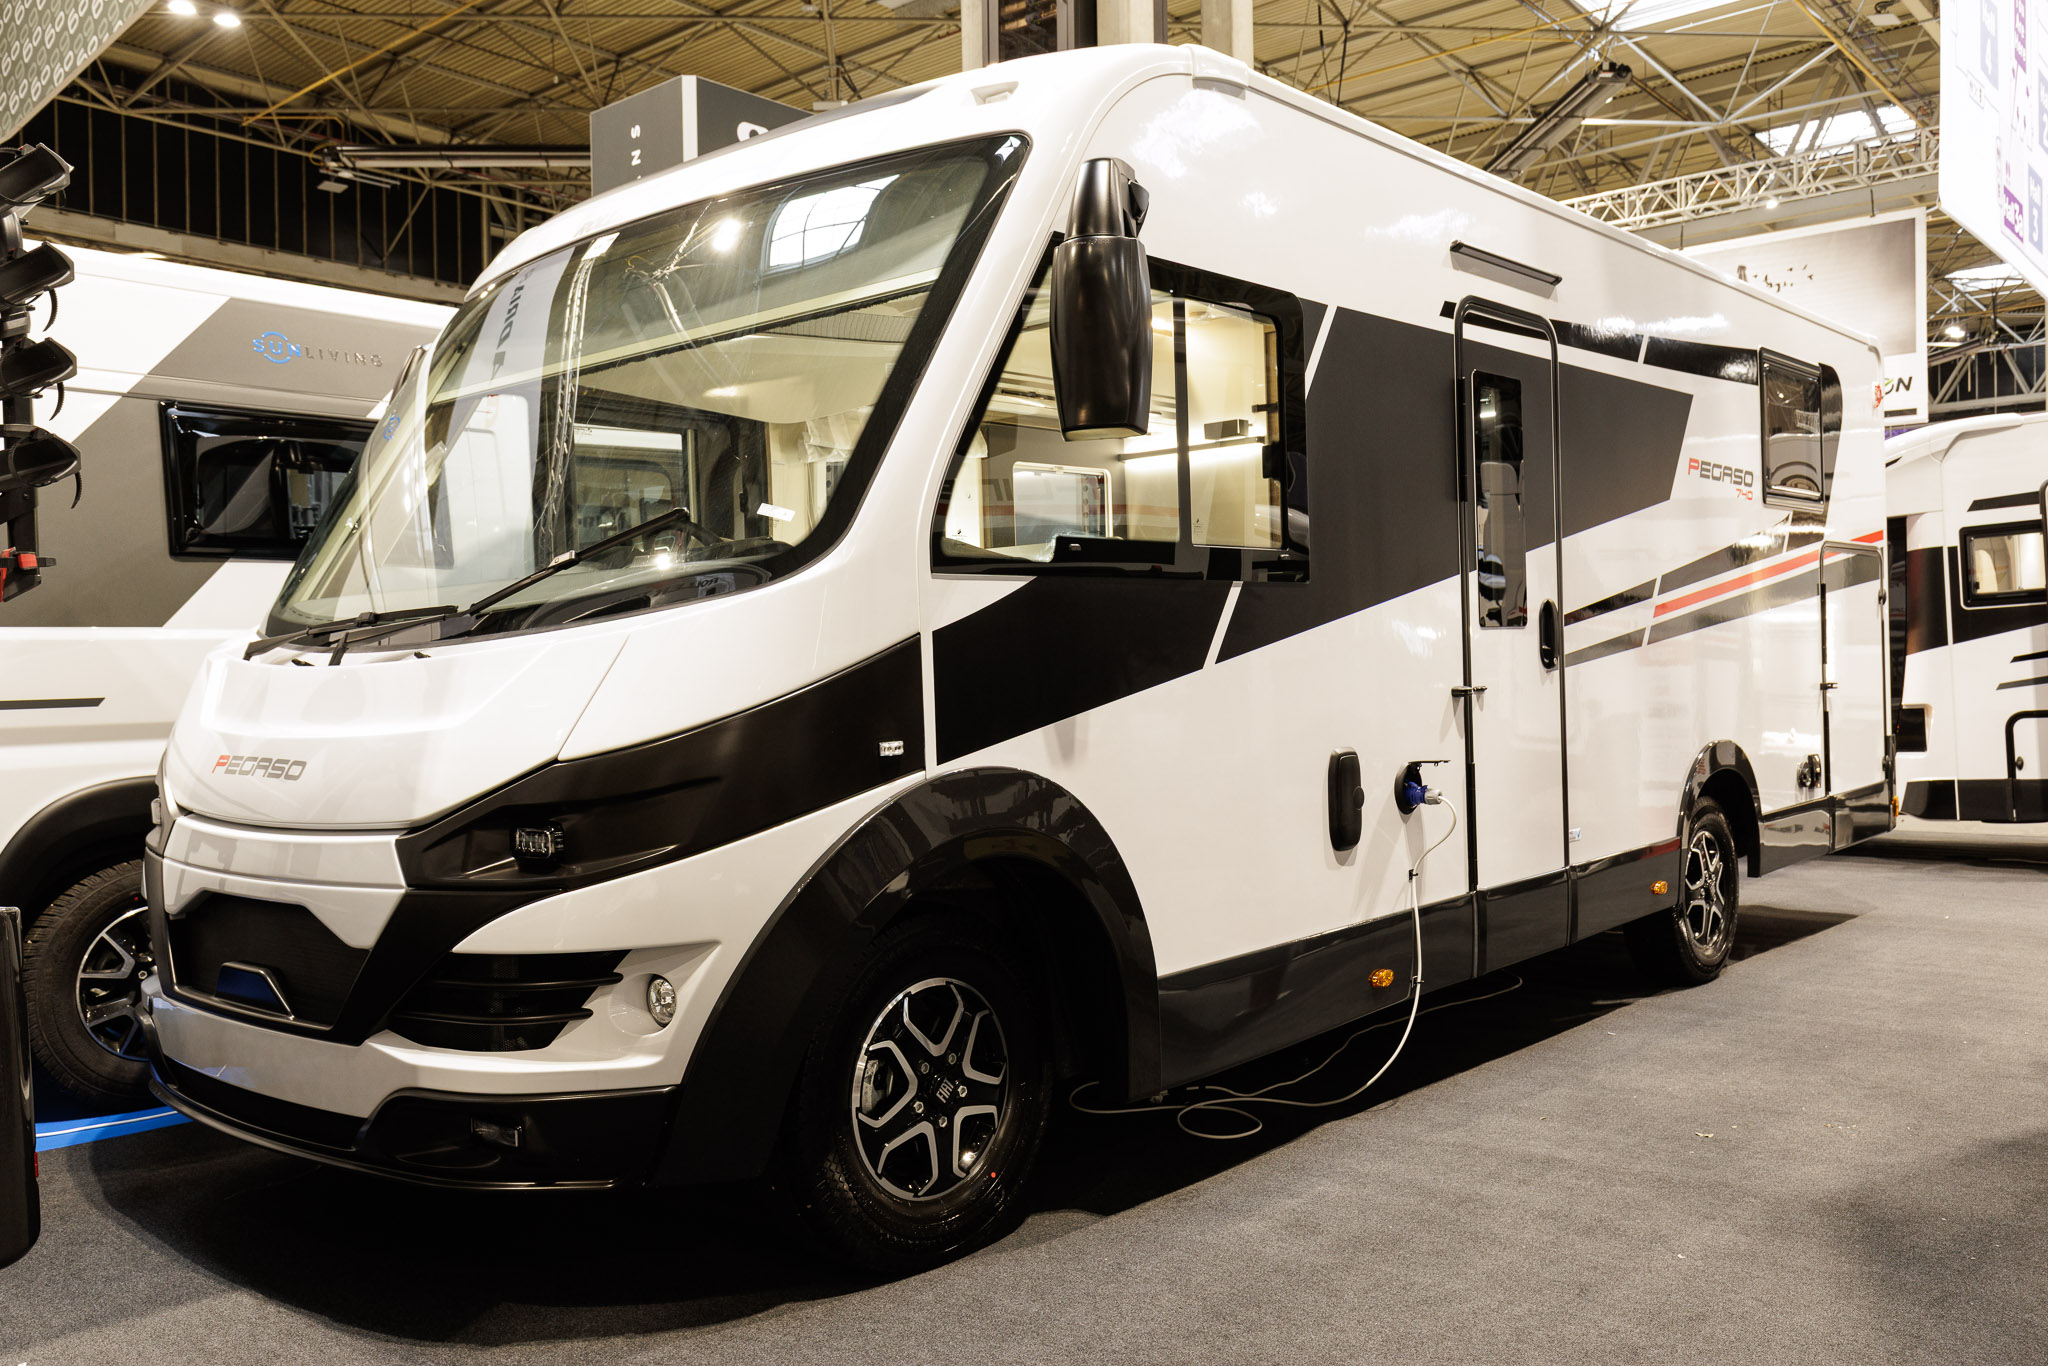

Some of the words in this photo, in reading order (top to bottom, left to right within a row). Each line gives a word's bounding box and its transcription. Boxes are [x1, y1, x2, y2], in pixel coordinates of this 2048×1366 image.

[1688, 457, 1754, 488] PEGASO
[1736, 488, 1753, 501] 740
[211, 754, 308, 781] PEGASO
[936, 1077, 954, 1104] FIAT
